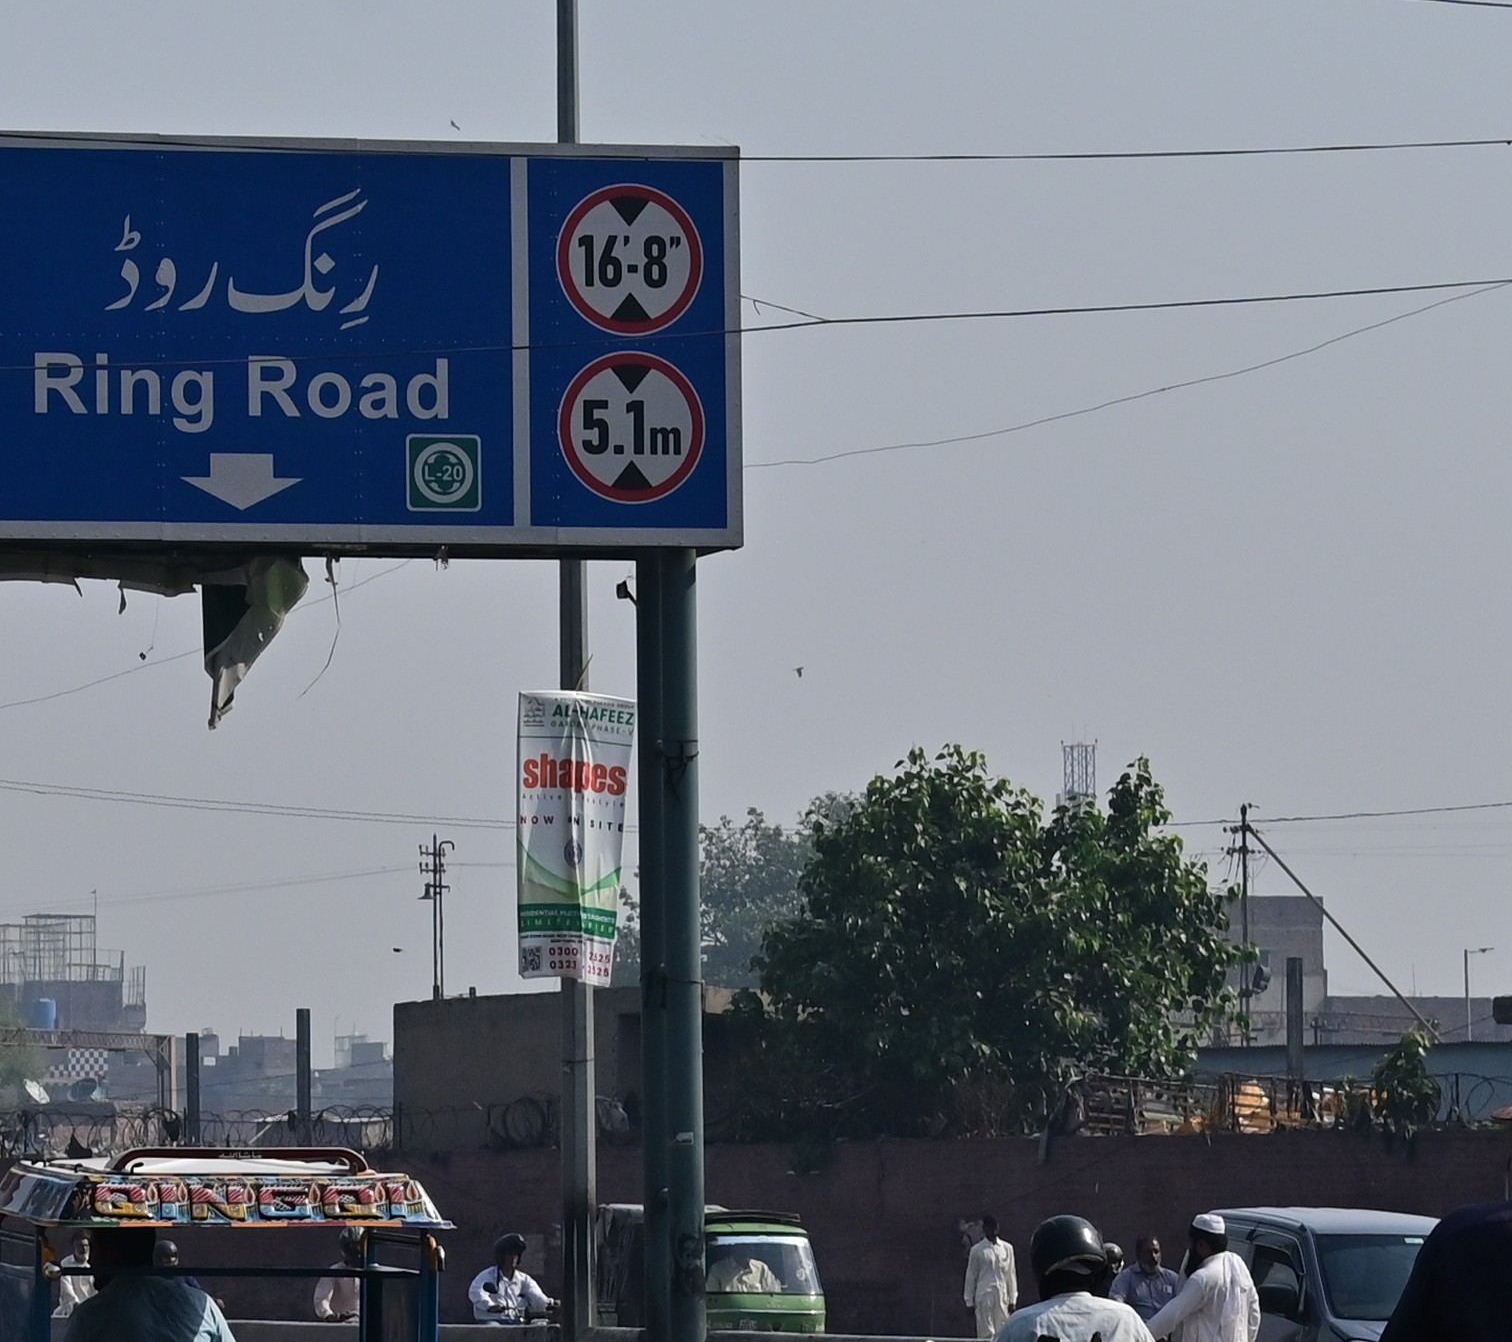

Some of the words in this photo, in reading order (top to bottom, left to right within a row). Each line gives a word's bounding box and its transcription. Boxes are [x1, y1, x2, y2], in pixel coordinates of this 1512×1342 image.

[105, 215, 220, 313] روڈ
[35, 352, 217, 432] Ring
[249, 356, 450, 421] Road
[581, 399, 682, 456] 5.1m
[423, 465, 464, 482] L-20
[523, 753, 627, 796] shapes
[520, 816, 554, 825] NOW
[590, 820, 624, 832] SITE
